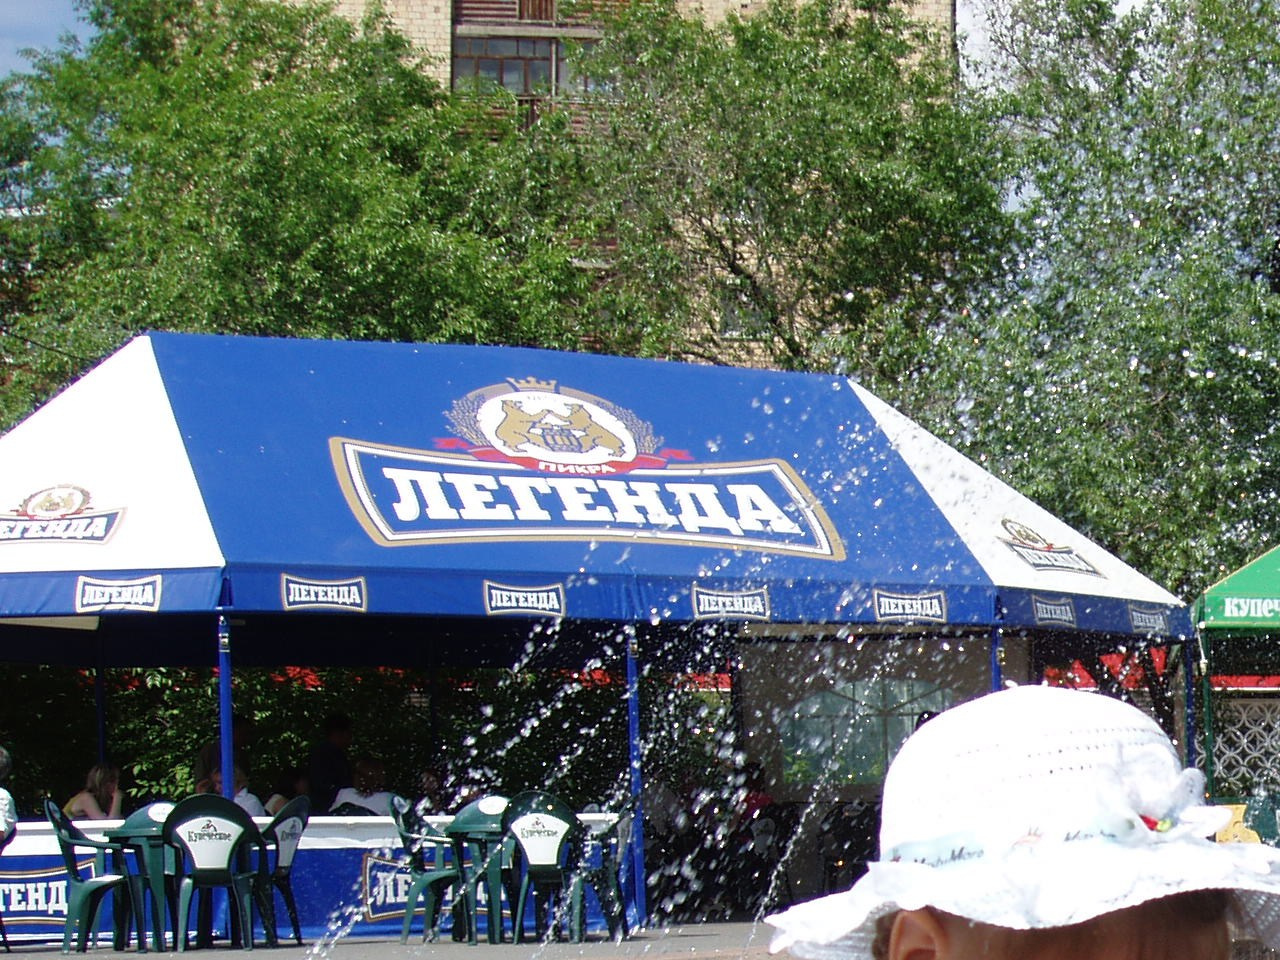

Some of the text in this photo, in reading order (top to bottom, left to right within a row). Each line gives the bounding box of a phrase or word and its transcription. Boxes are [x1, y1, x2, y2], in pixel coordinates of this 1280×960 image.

[538, 461, 617, 475] ПИКРА
[382, 466, 803, 535] ЛЕГЕНДА
[83, 583, 155, 606] ЛЕГЕНДА
[288, 582, 362, 605] ЛЕГЕНДА
[490, 588, 560, 610] ЛЕГЕНДА
[699, 594, 765, 614] ЛЕГЕНДА
[878, 596, 943, 616] ЛЕГЕНДА
